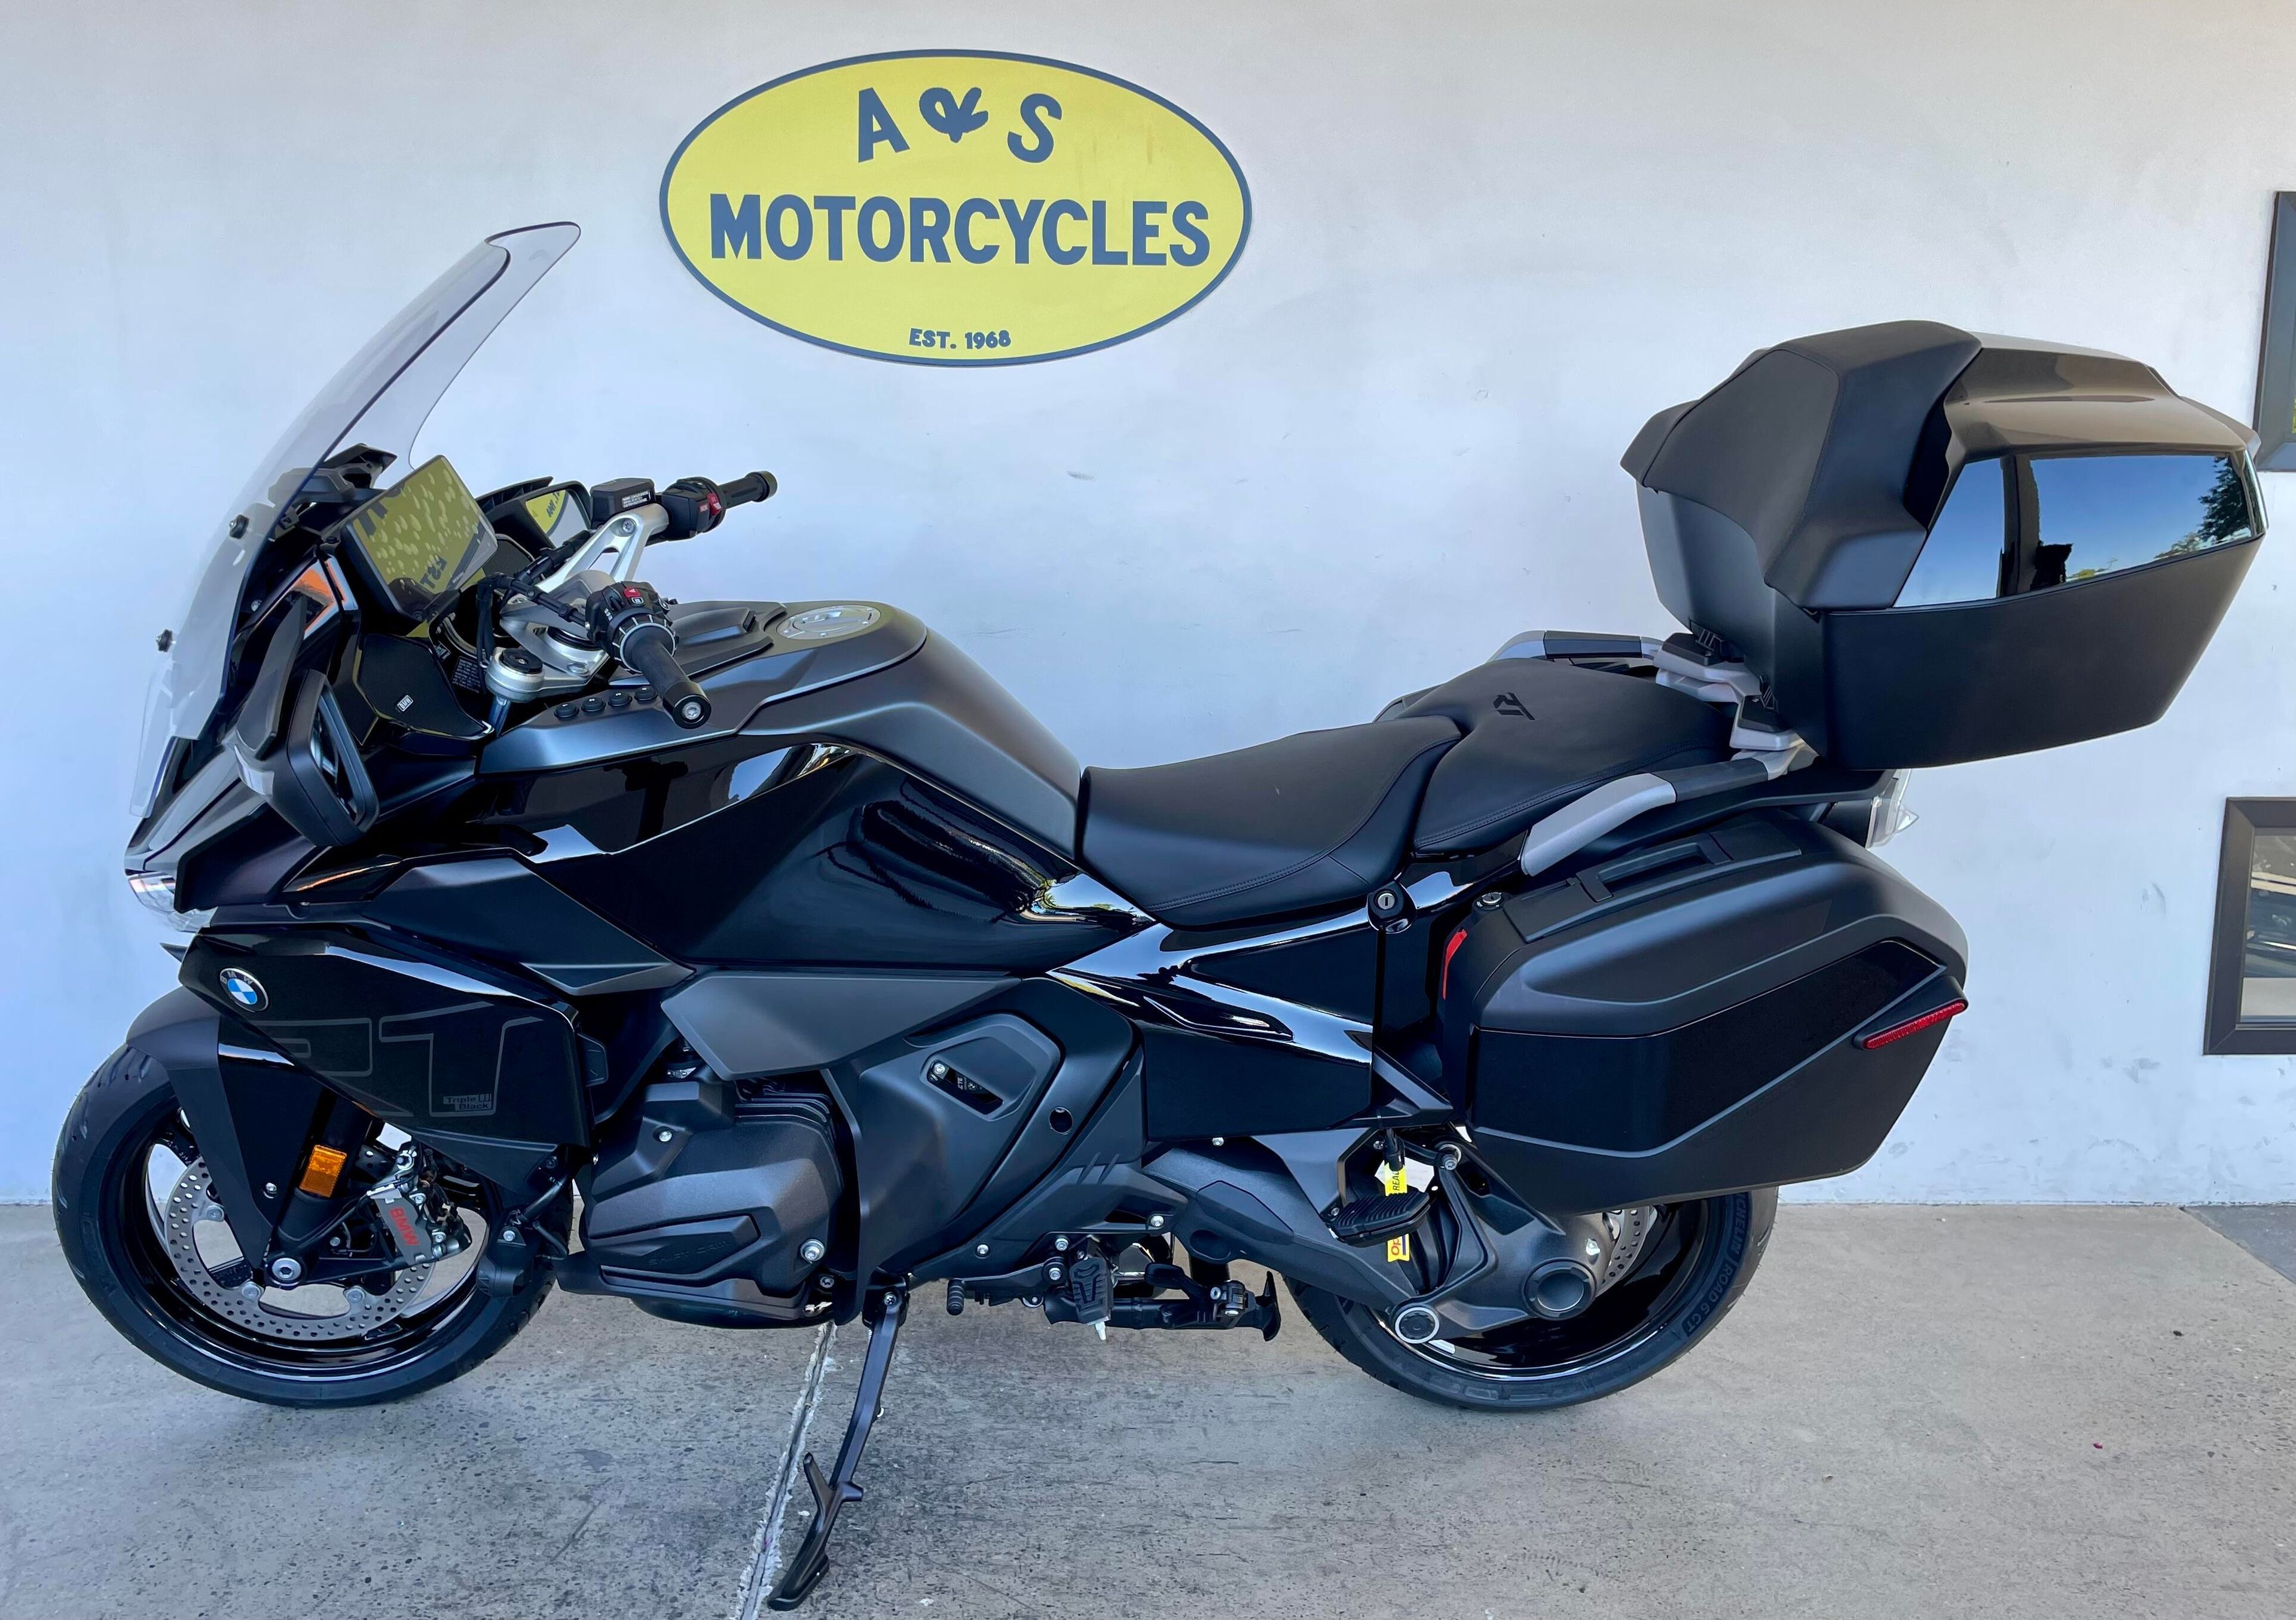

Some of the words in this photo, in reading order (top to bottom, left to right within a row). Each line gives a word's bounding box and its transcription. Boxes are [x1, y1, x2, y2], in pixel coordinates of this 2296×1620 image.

[858, 88, 909, 163] A
[1007, 93, 1062, 164] S
[710, 193, 1211, 267] MOTORCYCLES
[909, 328, 957, 349] EST.
[964, 329, 1012, 350] 1968
[398, 696, 412, 710] BMW
[446, 1096, 477, 1104] Triple
[389, 1206, 421, 1246] BMW
[1708, 1263, 1733, 1303] ROAD
[1700, 1303, 1710, 1315] 6
[1686, 1313, 1702, 1332] GT
